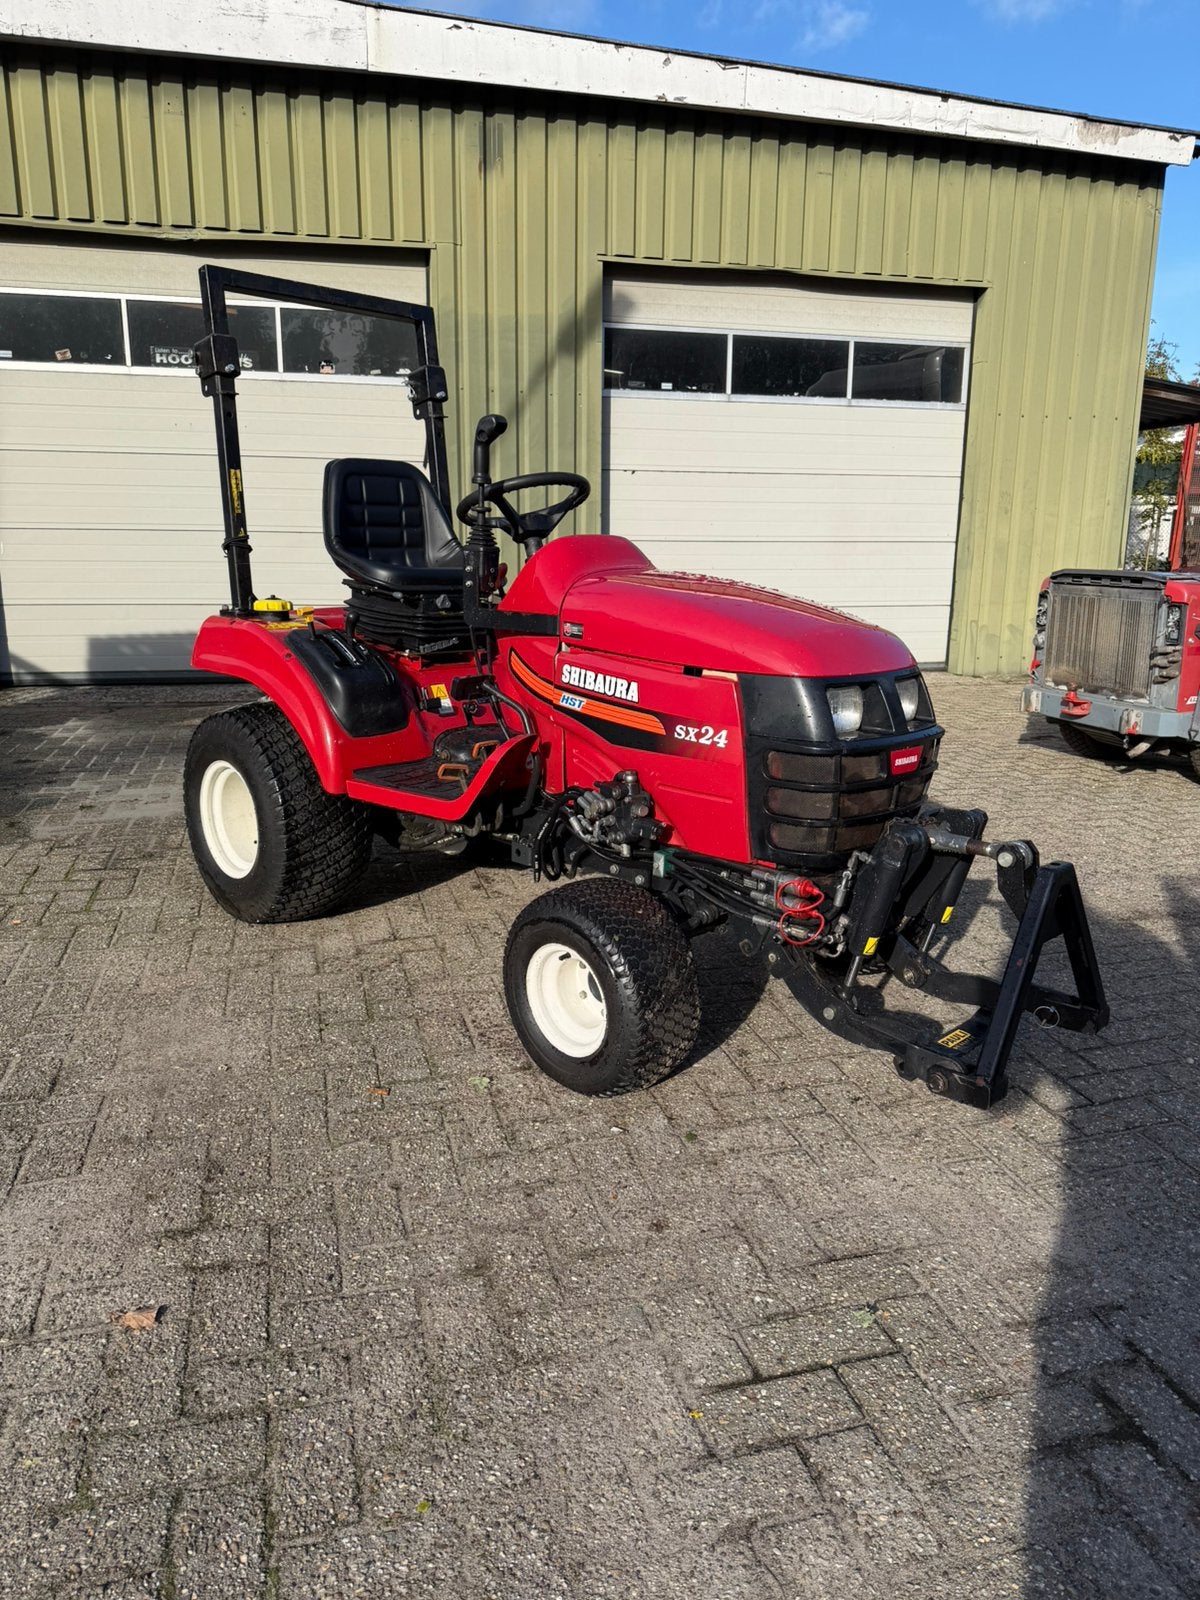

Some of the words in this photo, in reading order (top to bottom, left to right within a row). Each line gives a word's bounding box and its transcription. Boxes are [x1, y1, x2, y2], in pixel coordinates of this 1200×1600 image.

[561, 664, 639, 703] SHIBAURA
[560, 694, 586, 709] HST
[674, 724, 728, 748] SX24
